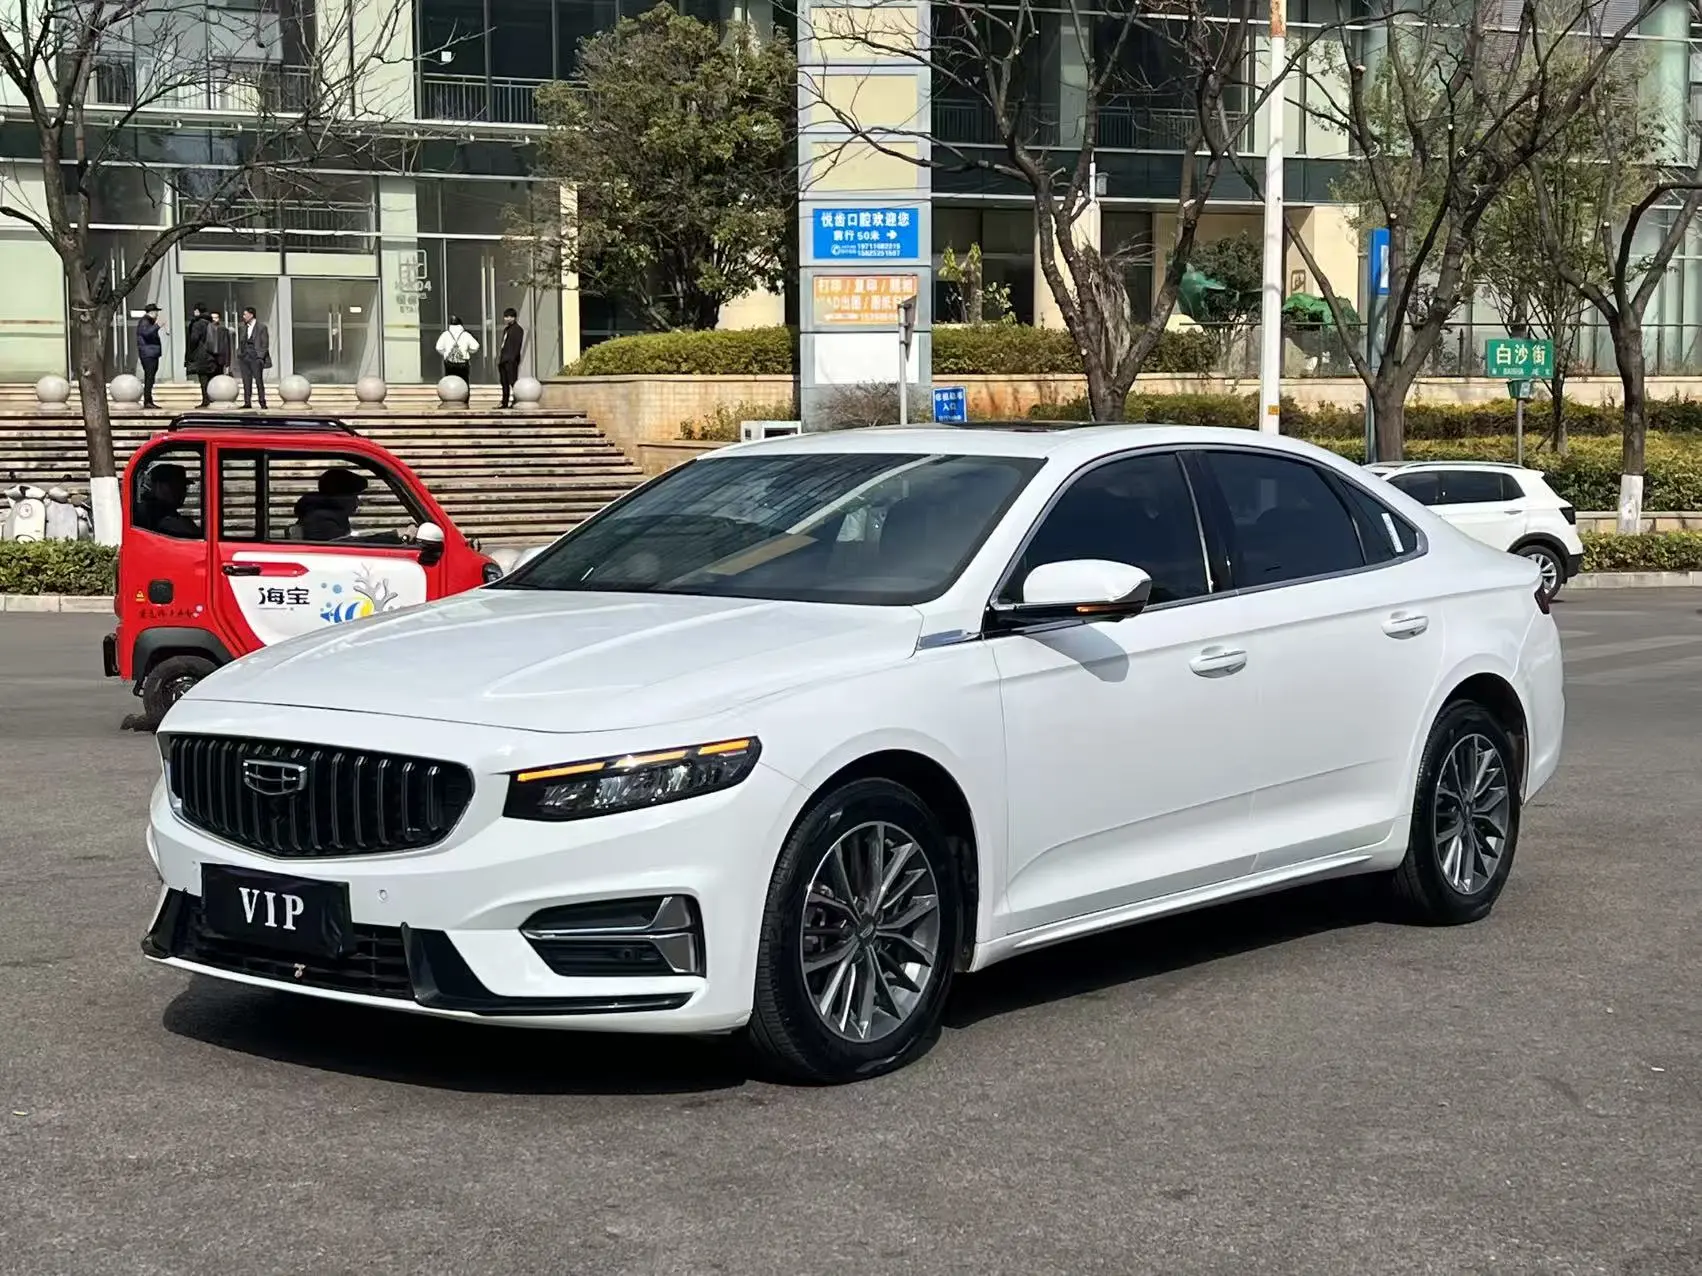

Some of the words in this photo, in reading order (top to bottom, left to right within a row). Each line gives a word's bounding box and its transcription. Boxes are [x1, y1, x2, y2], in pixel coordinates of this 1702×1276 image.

[821, 212, 910, 227] 悦齿口腔欢迎您
[1496, 343, 1546, 365] 白沙街
[257, 586, 310, 605] 海宝
[238, 887, 305, 931] VIP
